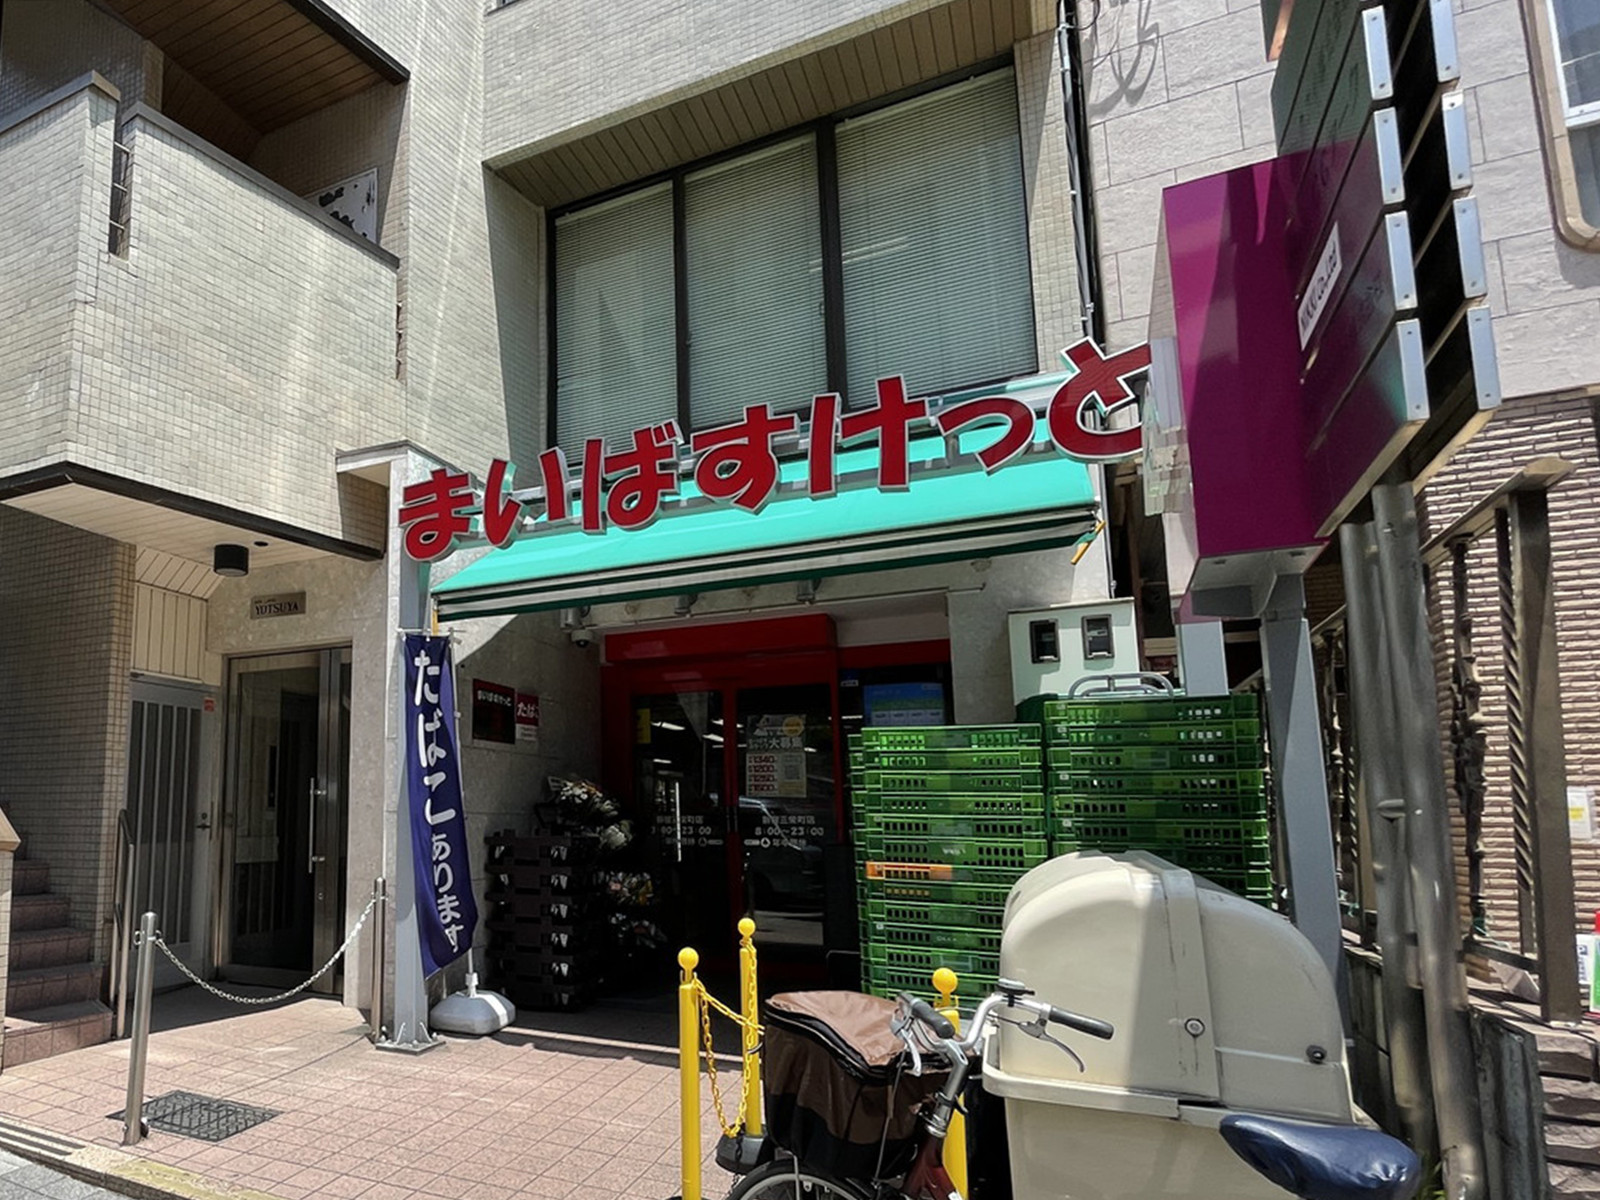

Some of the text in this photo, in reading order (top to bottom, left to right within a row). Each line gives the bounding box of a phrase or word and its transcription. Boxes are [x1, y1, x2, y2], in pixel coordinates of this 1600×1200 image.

[398, 336, 1151, 562] まいばすけっと
[255, 600, 299, 616] YOTSUYA
[414, 649, 465, 954] たばこあります
